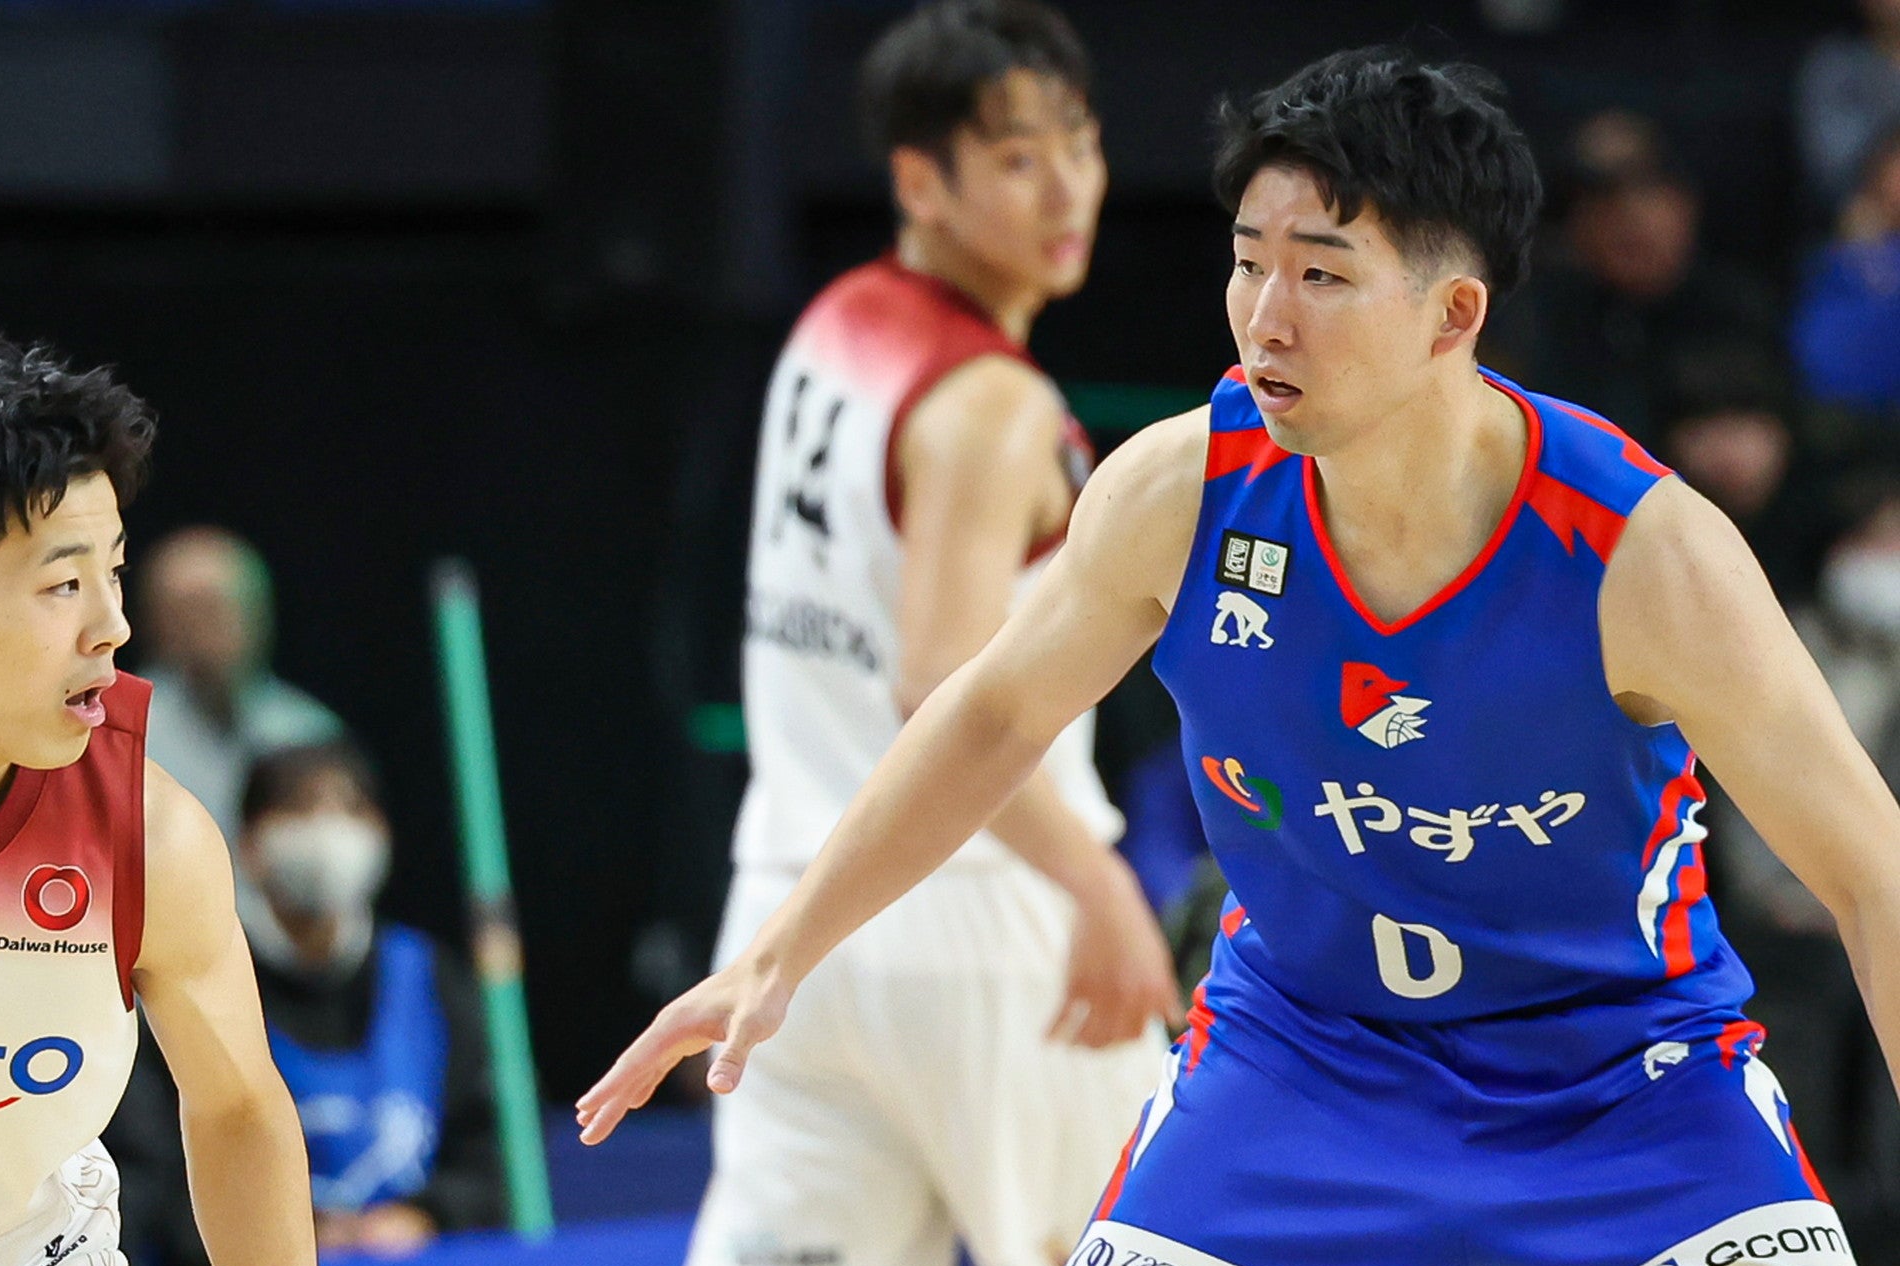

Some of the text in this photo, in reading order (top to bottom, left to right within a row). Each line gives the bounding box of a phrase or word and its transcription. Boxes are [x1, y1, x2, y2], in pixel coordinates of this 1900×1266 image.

[1313, 781, 1587, 863] やずや
[53, 940, 109, 954] House
